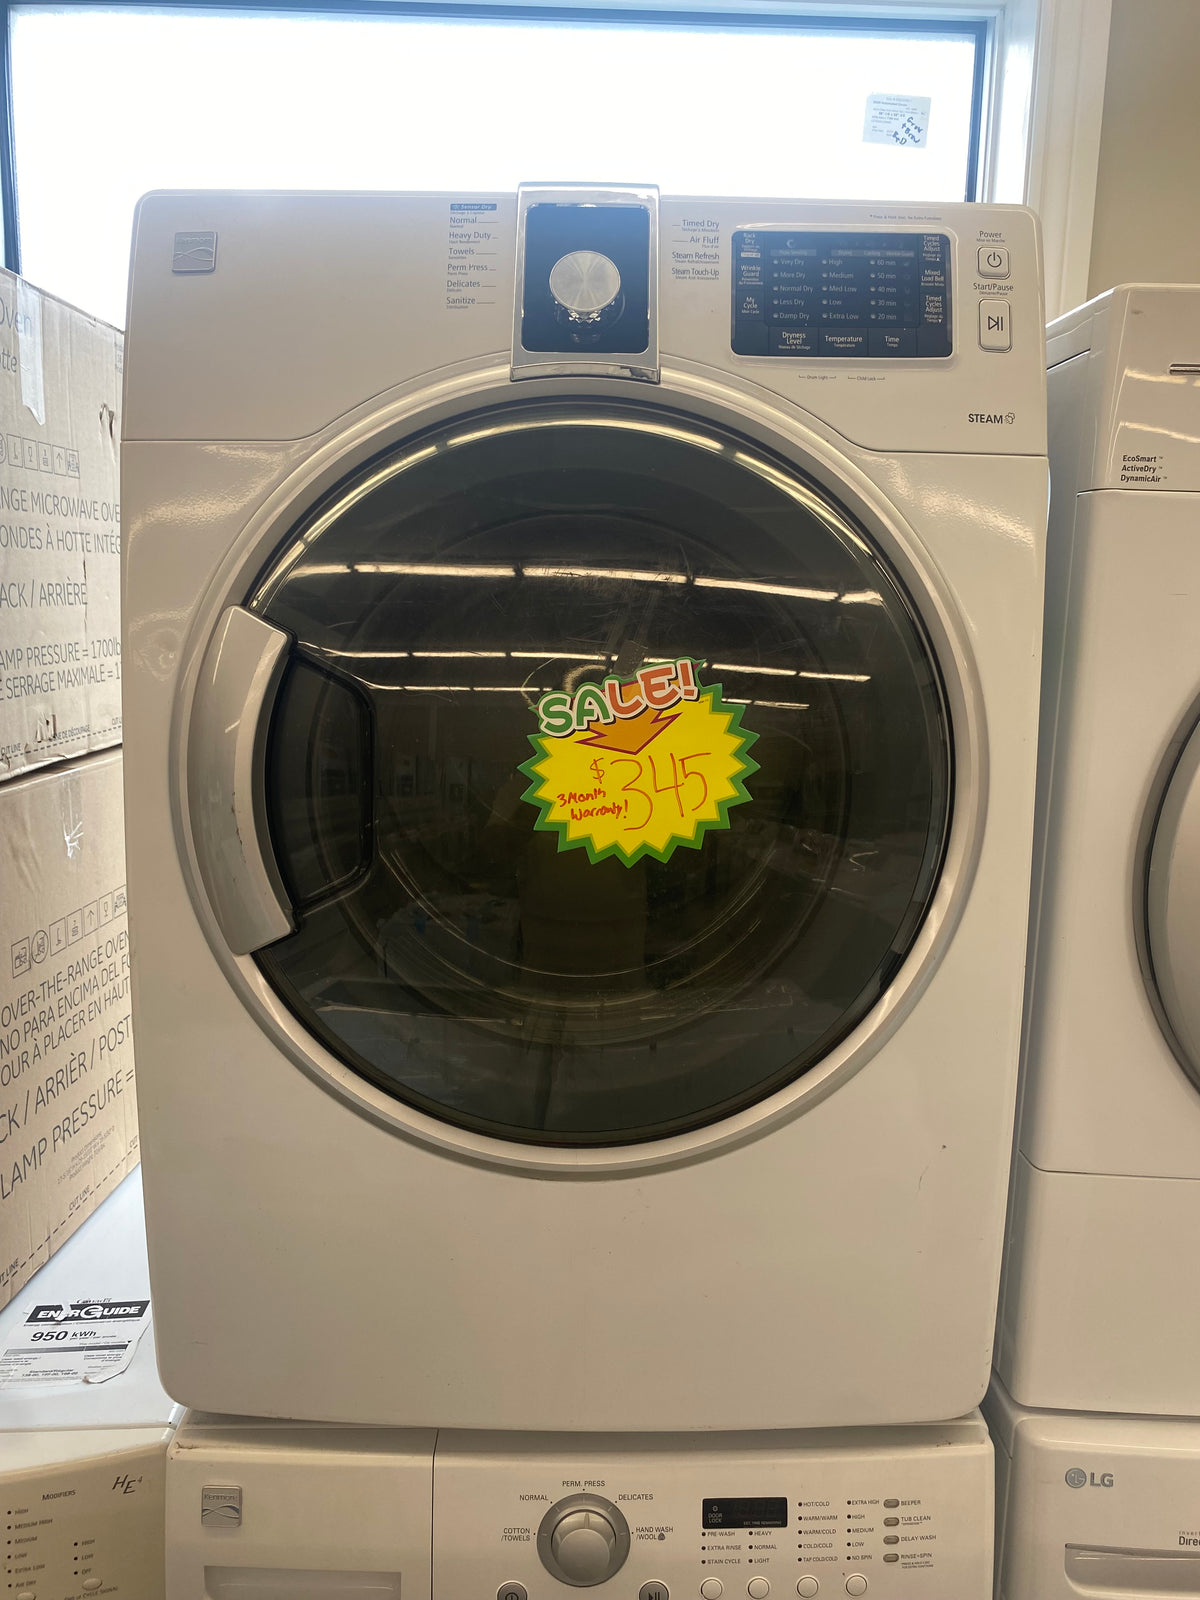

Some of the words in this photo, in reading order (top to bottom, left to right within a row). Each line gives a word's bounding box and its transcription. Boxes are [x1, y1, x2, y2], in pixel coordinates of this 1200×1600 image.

[682, 219, 705, 227] Timed
[707, 219, 719, 229] Dry
[449, 232, 472, 240] Heavy
[473, 231, 491, 240] Duty
[979, 230, 1002, 238] Power
[702, 236, 719, 244] Fluff
[449, 247, 475, 255] Towels
[672, 251, 693, 259] Steam
[695, 252, 720, 260] Refresh
[447, 263, 466, 271] Perm
[469, 263, 488, 271] Press
[828, 259, 843, 267] High
[672, 267, 690, 275] Steam
[691, 268, 720, 277] Touch-Up
[973, 282, 1014, 291] Start/Pause
[446, 296, 476, 304] Sanitize
[782, 331, 806, 339] Dryness
[824, 335, 863, 344] Temperature
[884, 335, 900, 343] Time
[0, 347, 17, 373] tte
[967, 413, 1003, 424] STEAM
[1122, 455, 1157, 463] EcoSmart
[1121, 464, 1157, 473] ActiveDry
[1120, 474, 1162, 483] DynamicAir
[0, 486, 28, 512] NGE
[31, 491, 99, 521] MICROWAVE
[45, 522, 54, 550] À
[56, 530, 92, 553] HOTTE
[39, 576, 88, 608] ARRIÈRE
[26, 642, 81, 669] PRESSURE
[5, 672, 55, 700] SERRAGE
[57, 664, 106, 690] MAXIMALE
[538, 659, 699, 737] SALE!
[1, 945, 103, 1028] OVER-THE-RANGE
[24, 1005, 56, 1042] PARA
[57, 975, 100, 1019] ENCIMA
[101, 962, 120, 988] DEL
[0, 1050, 30, 1086] OUR
[32, 1037, 42, 1064] À
[44, 1009, 86, 1056] PLACER
[88, 1000, 102, 1022] EN
[34, 1052, 87, 1115] ARRIÈR
[99, 1014, 131, 1060] POST
[0, 1136, 48, 1200] LAMP
[53, 1069, 123, 1153] PRESSURE
[36, 1304, 142, 1320] ENRGUIDE
[30, 1330, 69, 1342] 950
[71, 1330, 97, 1338] kWh
[1089, 1472, 1114, 1488] LG
[41, 1489, 76, 1501] MODIFIERS
[618, 1493, 654, 1501] DELICATES
[635, 1526, 654, 1534] HAND
[500, 1534, 531, 1542] /TOWELS
[636, 1533, 657, 1541] /WOOL
